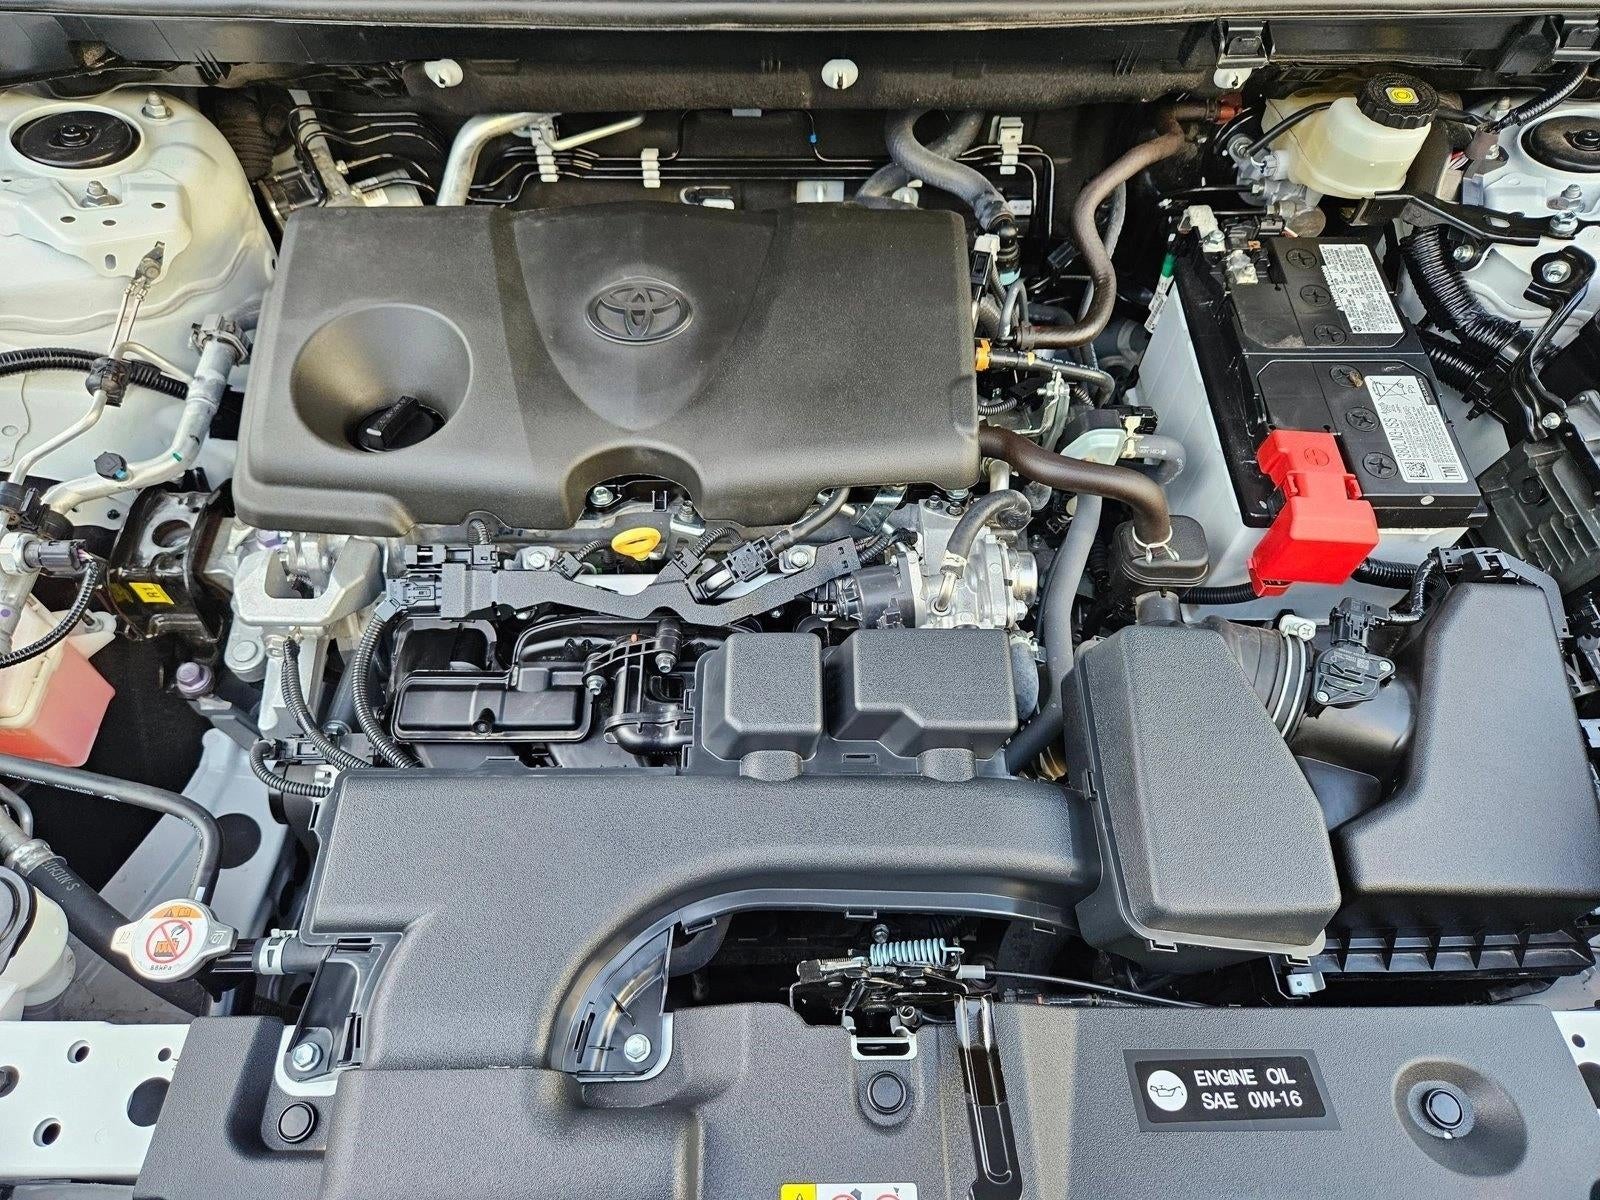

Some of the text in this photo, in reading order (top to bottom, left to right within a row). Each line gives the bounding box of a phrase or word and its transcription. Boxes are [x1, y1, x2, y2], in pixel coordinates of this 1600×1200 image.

[1193, 1067, 1297, 1087] ENGINE OIL
[1201, 1090, 1304, 1110] SAE 0W-16
